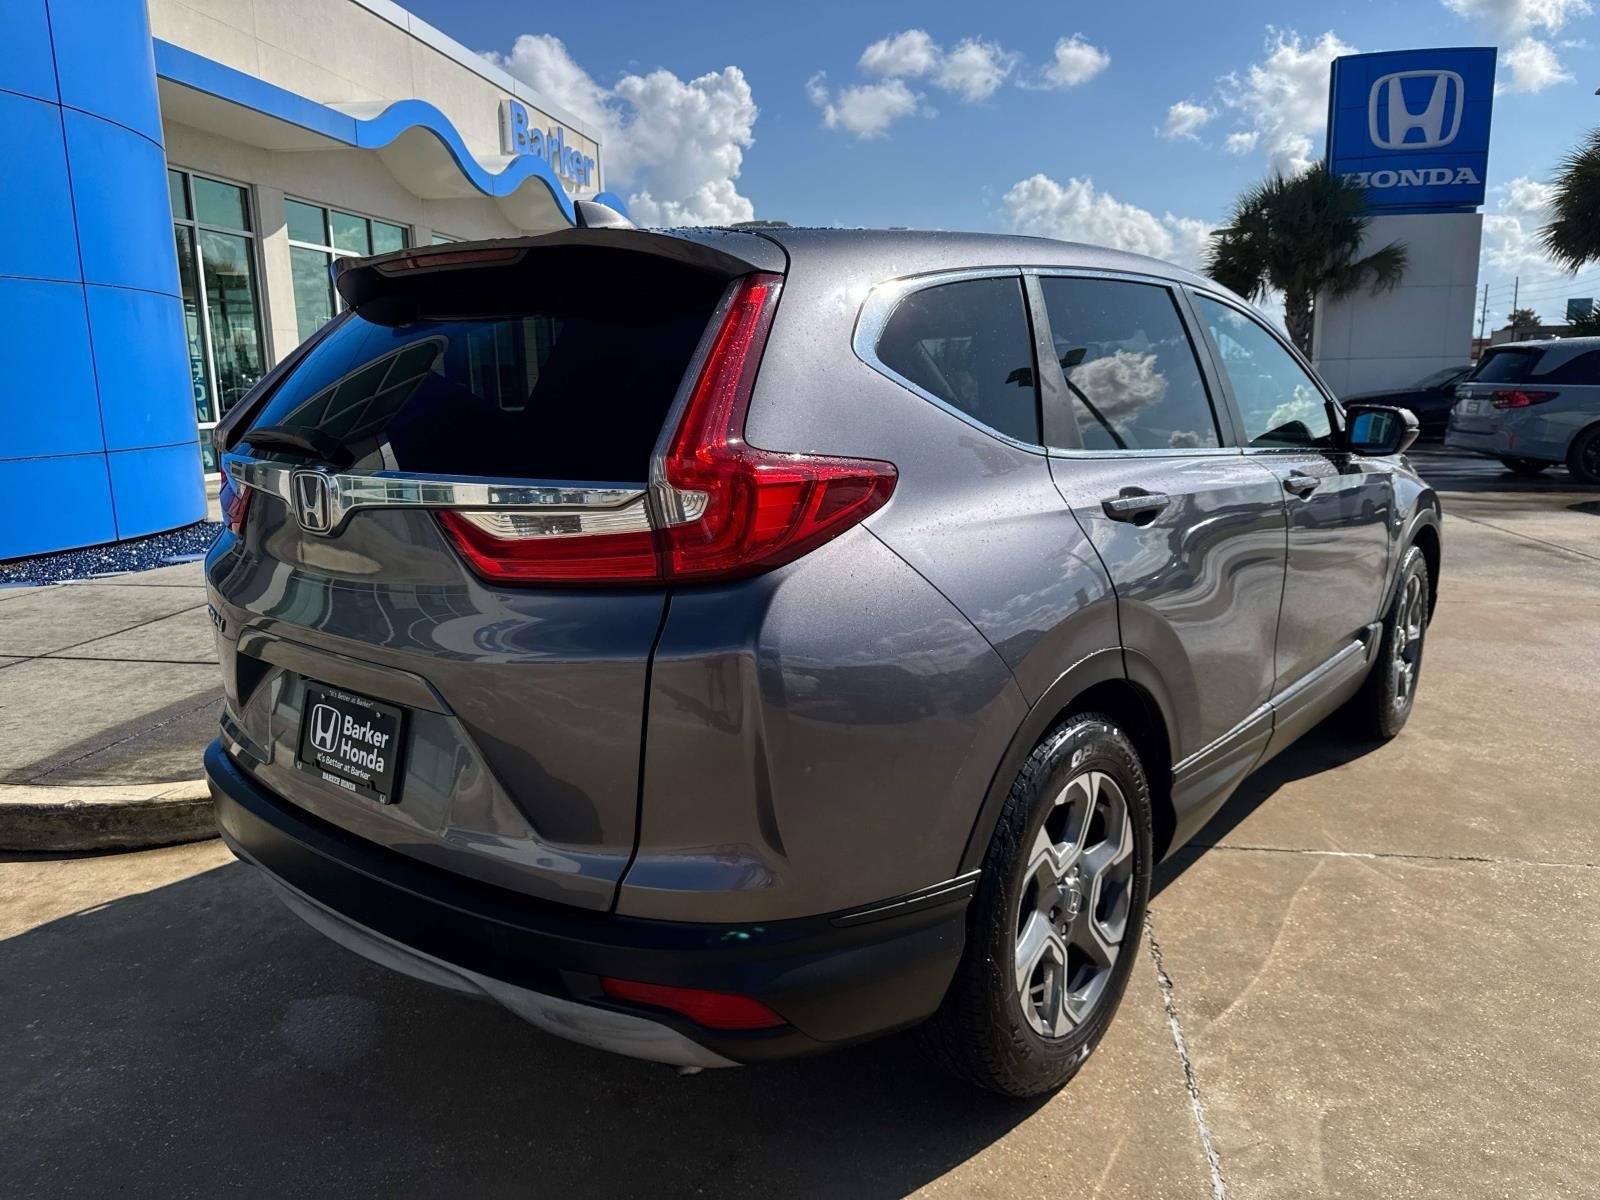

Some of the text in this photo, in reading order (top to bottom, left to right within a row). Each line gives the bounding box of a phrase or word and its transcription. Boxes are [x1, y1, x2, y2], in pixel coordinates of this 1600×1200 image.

[506, 99, 595, 187] Barker
[1341, 167, 1481, 190] HONDA
[343, 714, 389, 749] Barker
[325, 756, 343, 770] Better
[350, 765, 371, 781] Barker
[340, 737, 385, 773] Honda
